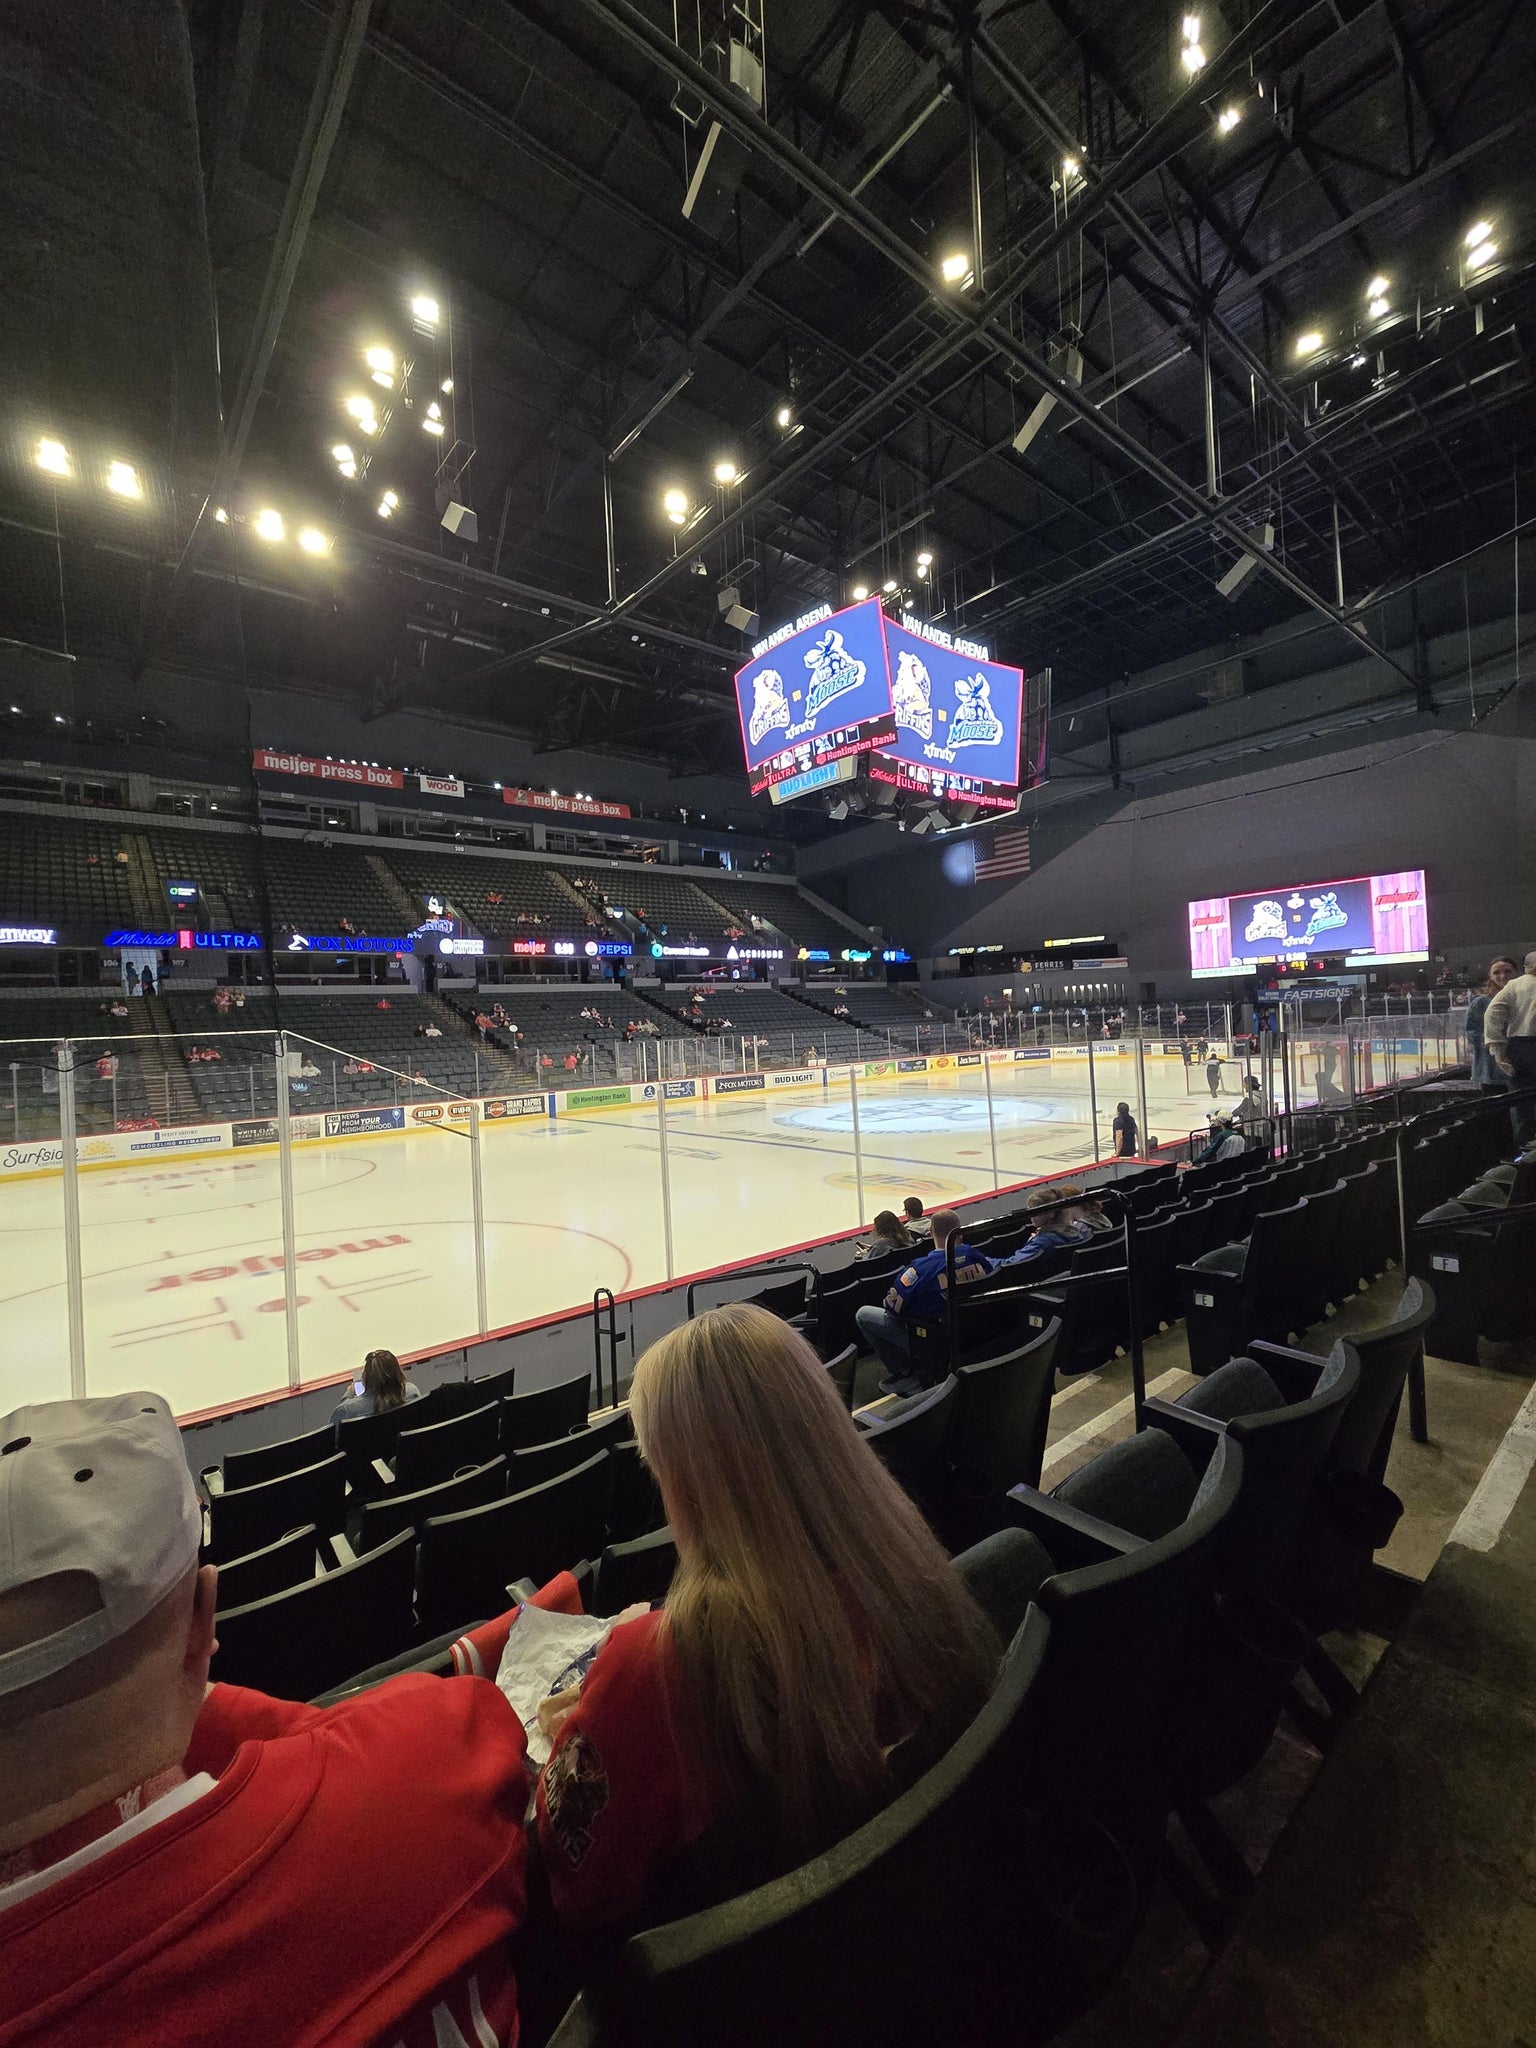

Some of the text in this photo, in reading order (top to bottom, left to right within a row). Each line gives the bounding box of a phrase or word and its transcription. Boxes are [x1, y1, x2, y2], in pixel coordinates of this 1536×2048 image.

[768, 622, 797, 649] ANDEL
[797, 603, 834, 631] ARENA
[902, 612, 990, 661] VAN ANDEL ARENA
[807, 666, 860, 711] MOOSE
[785, 718, 817, 740] xfinity
[950, 723, 998, 742] MOOSE
[826, 732, 896, 761] Huntington Bank
[923, 742, 957, 763] xfinity
[264, 755, 393, 785] meijer press box
[772, 767, 798, 782] ULTRA
[426, 781, 459, 792] WOOD
[780, 763, 838, 797] BUD LIGHT
[901, 776, 929, 793] ULTRA
[533, 793, 621, 816] meijer press box
[958, 791, 1016, 809] Huntington Bank
[0, 928, 55, 944] mway
[194, 933, 260, 948] ULTRA
[308, 937, 415, 953] FOX MOTORS
[513, 940, 546, 955] meijer
[598, 944, 632, 955] PEPSI
[102, 959, 119, 967] 106
[389, 961, 400, 969] 107
[1034, 960, 1065, 969] FERRIS
[1284, 986, 1353, 1001] FASTSIGNS
[738, 1079, 763, 1087] MOTORS
[775, 1074, 814, 1084] BUD LIGHT
[341, 1112, 360, 1120] NEWS
[341, 1116, 381, 1127] FROM YOUR
[327, 1122, 340, 1134] 17
[3, 1147, 80, 1168] Surfsi
